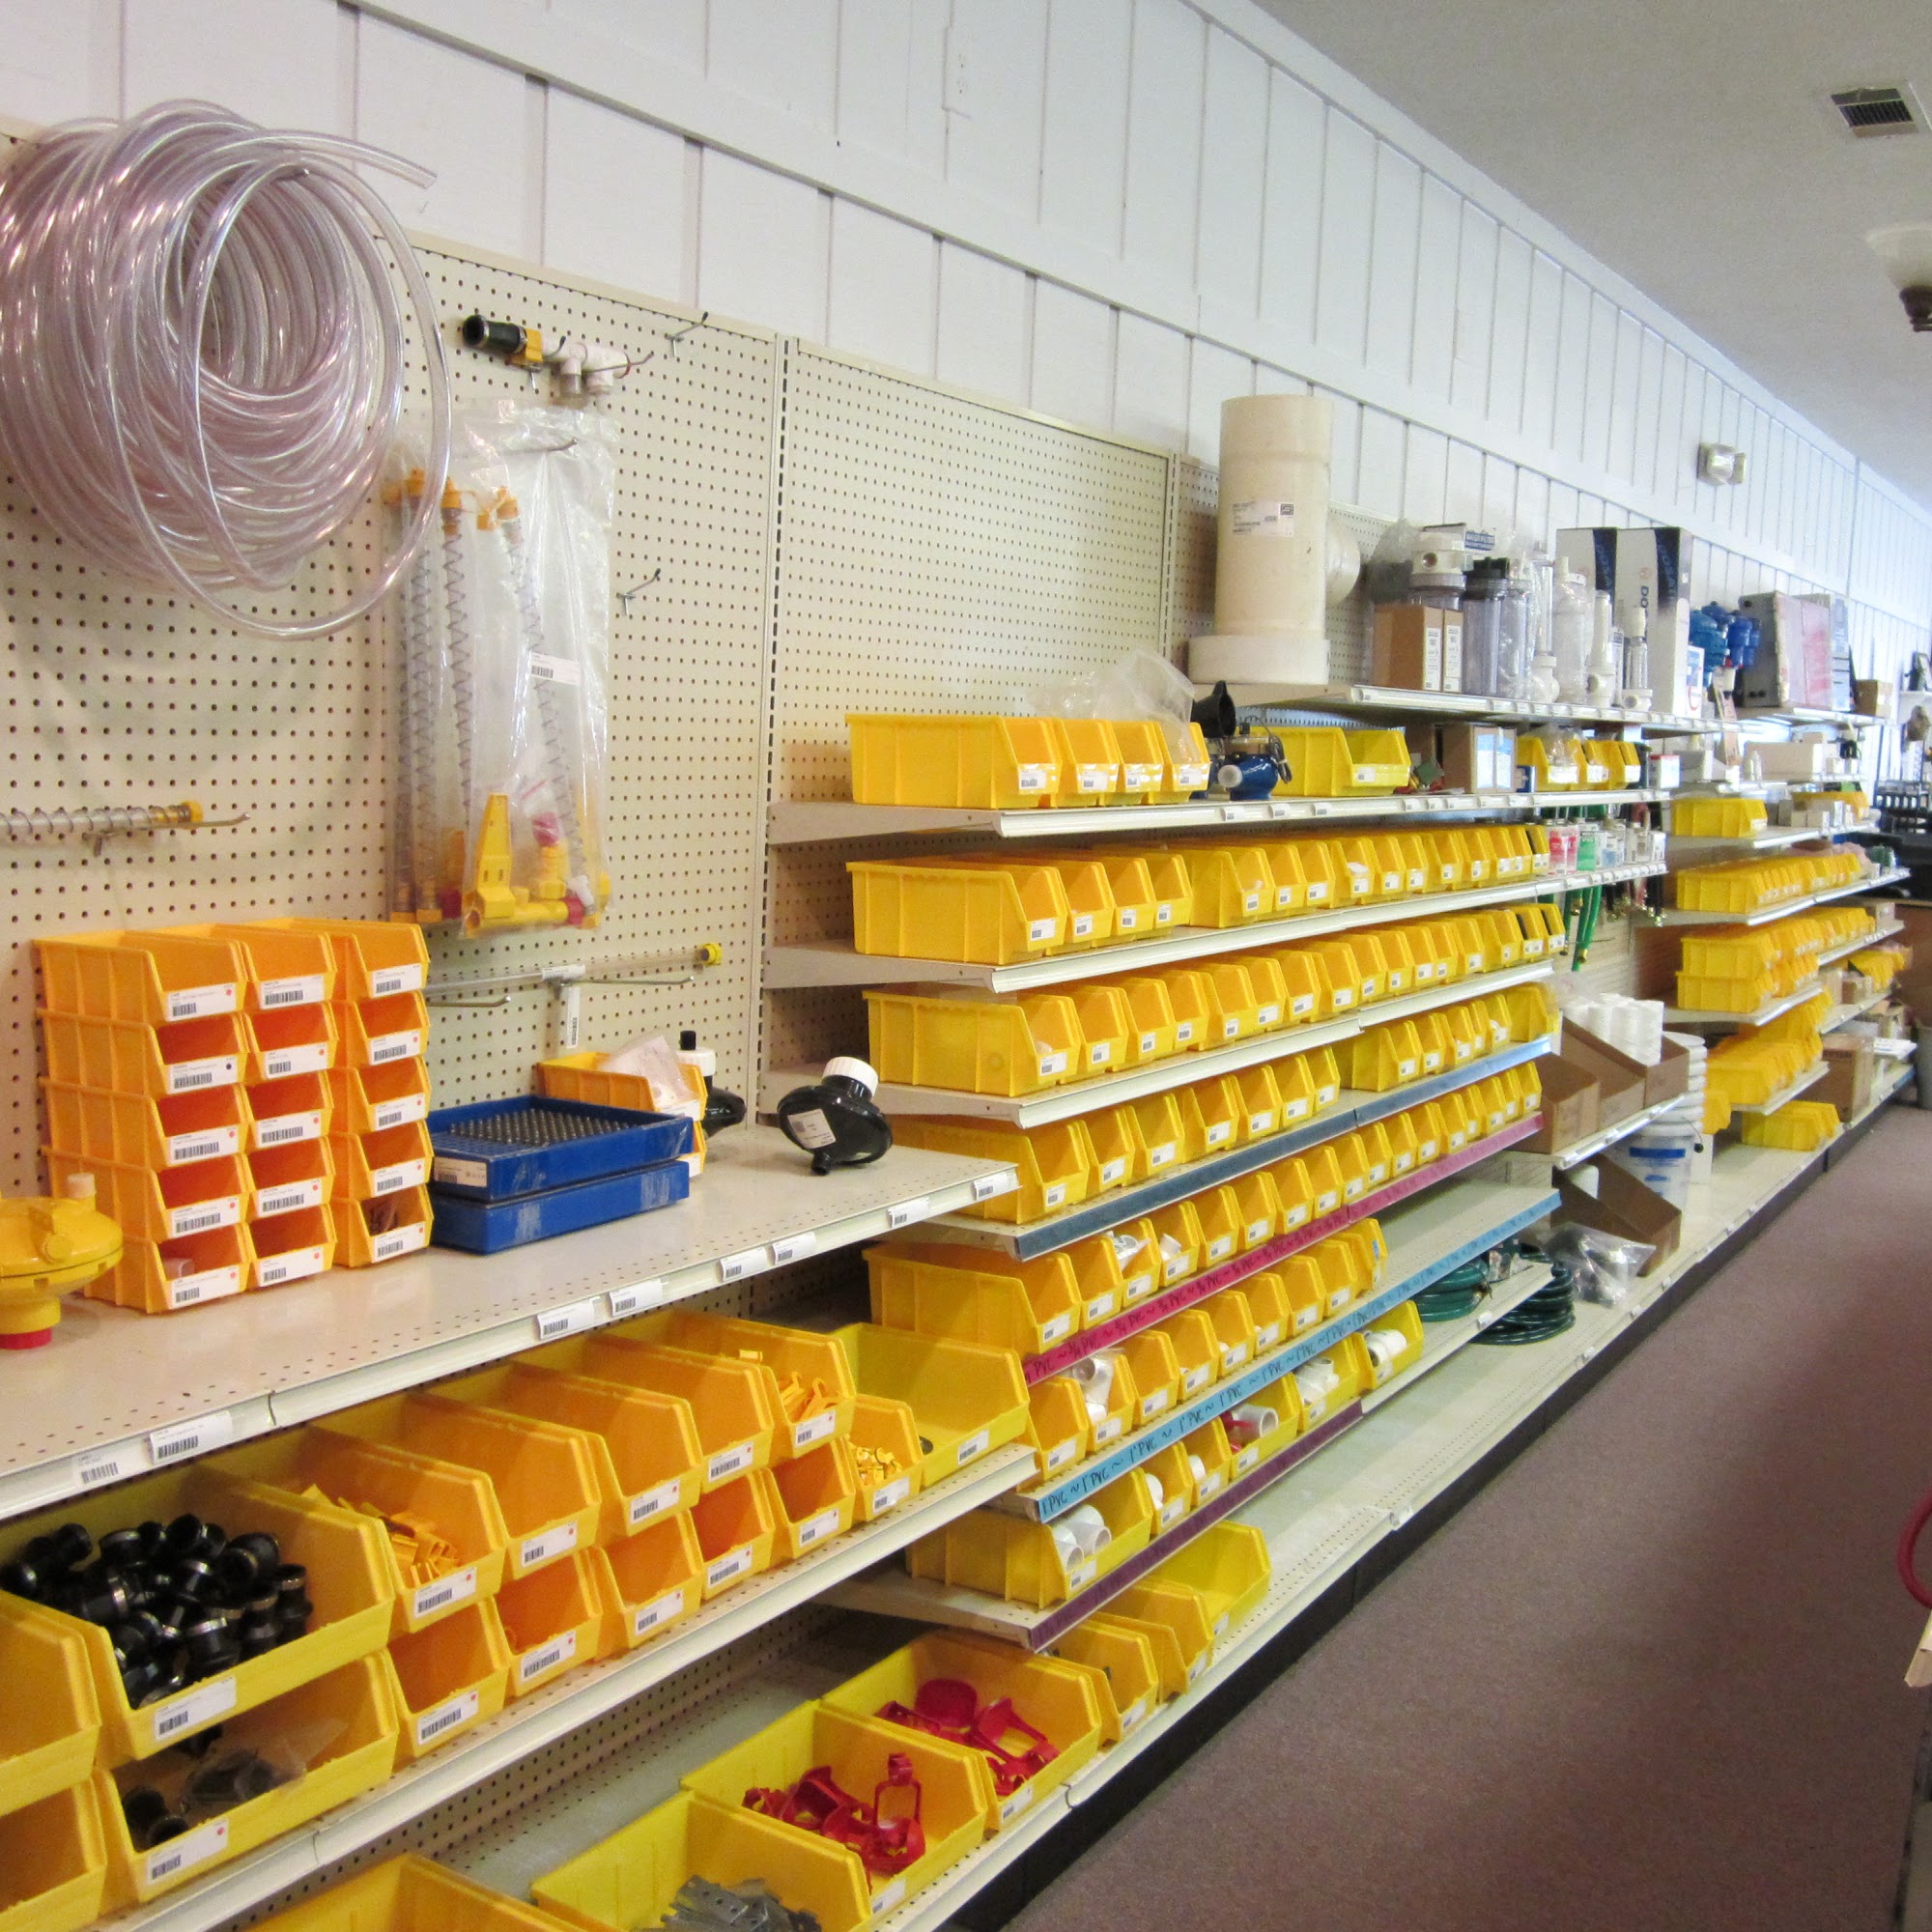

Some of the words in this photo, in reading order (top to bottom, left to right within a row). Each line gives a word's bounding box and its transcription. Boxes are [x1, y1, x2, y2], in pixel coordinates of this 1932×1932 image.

[1035, 1356, 1053, 1378] PVC
[1049, 1492, 1067, 1512] PVC
[1090, 1467, 1109, 1486] PVC
[1138, 1436, 1157, 1456] PVC
[1187, 1408, 1204, 1426] PVC
[1226, 1384, 1242, 1402] PVC
[1267, 1360, 1282, 1378] PVC
